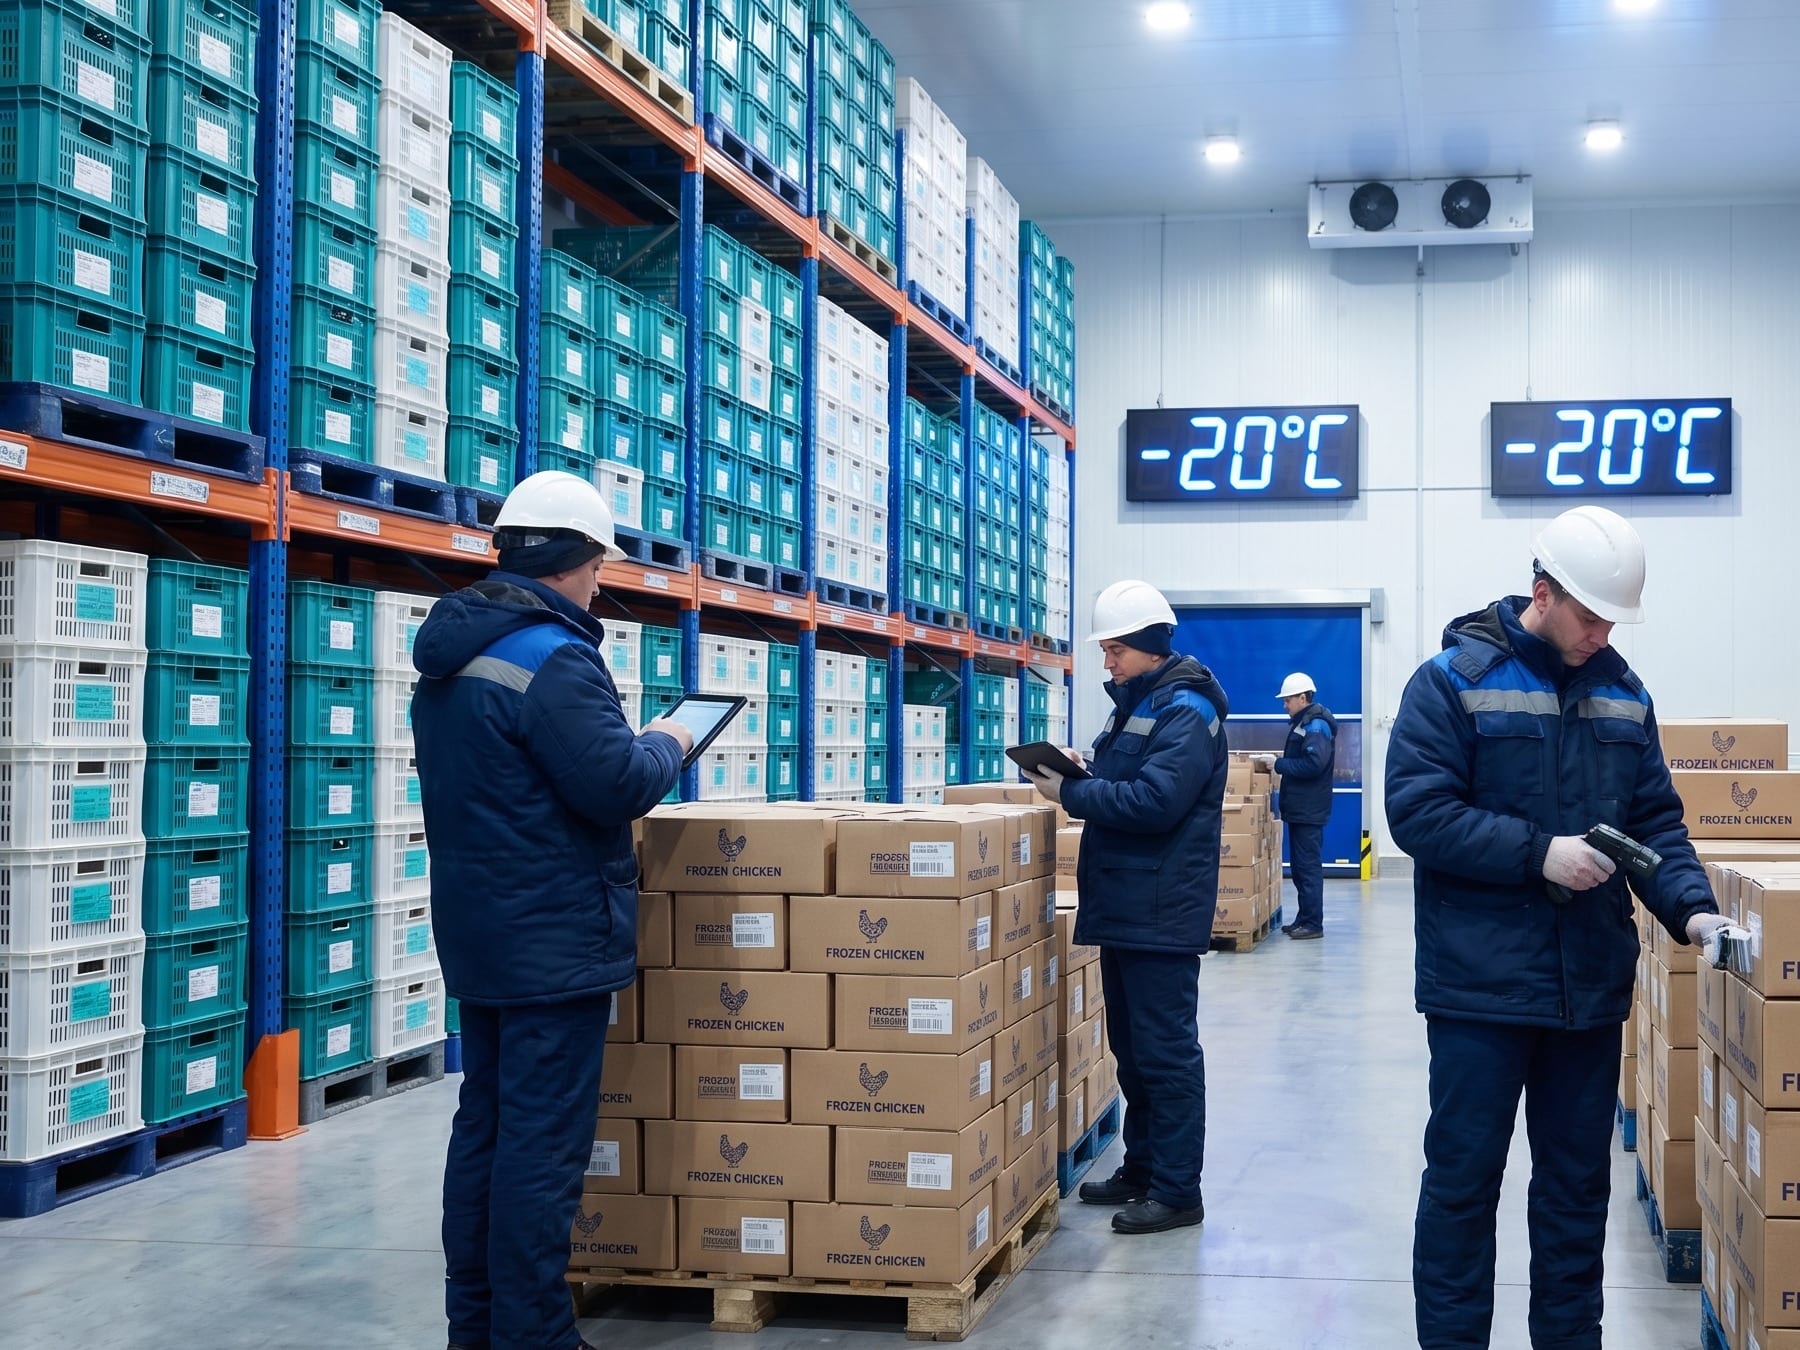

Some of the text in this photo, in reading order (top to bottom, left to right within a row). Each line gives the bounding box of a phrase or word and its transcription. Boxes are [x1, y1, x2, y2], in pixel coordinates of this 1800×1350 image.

[1141, 414, 1349, 490] -20°C
[1506, 407, 1722, 485] -20°C
[1700, 815, 1793, 825] FROZEN CHICKEN
[686, 865, 728, 876] FROZEN
[826, 947, 925, 961] FROZEN CHICKEN
[688, 1018, 785, 1032] FROZEN CHICKEN
[874, 1102, 925, 1114] CHICKEN
[687, 1171, 784, 1186] FROZEN CHICKEN
[590, 1242, 638, 1255] CHICKEN
[875, 1255, 926, 1267] CHICKEN
